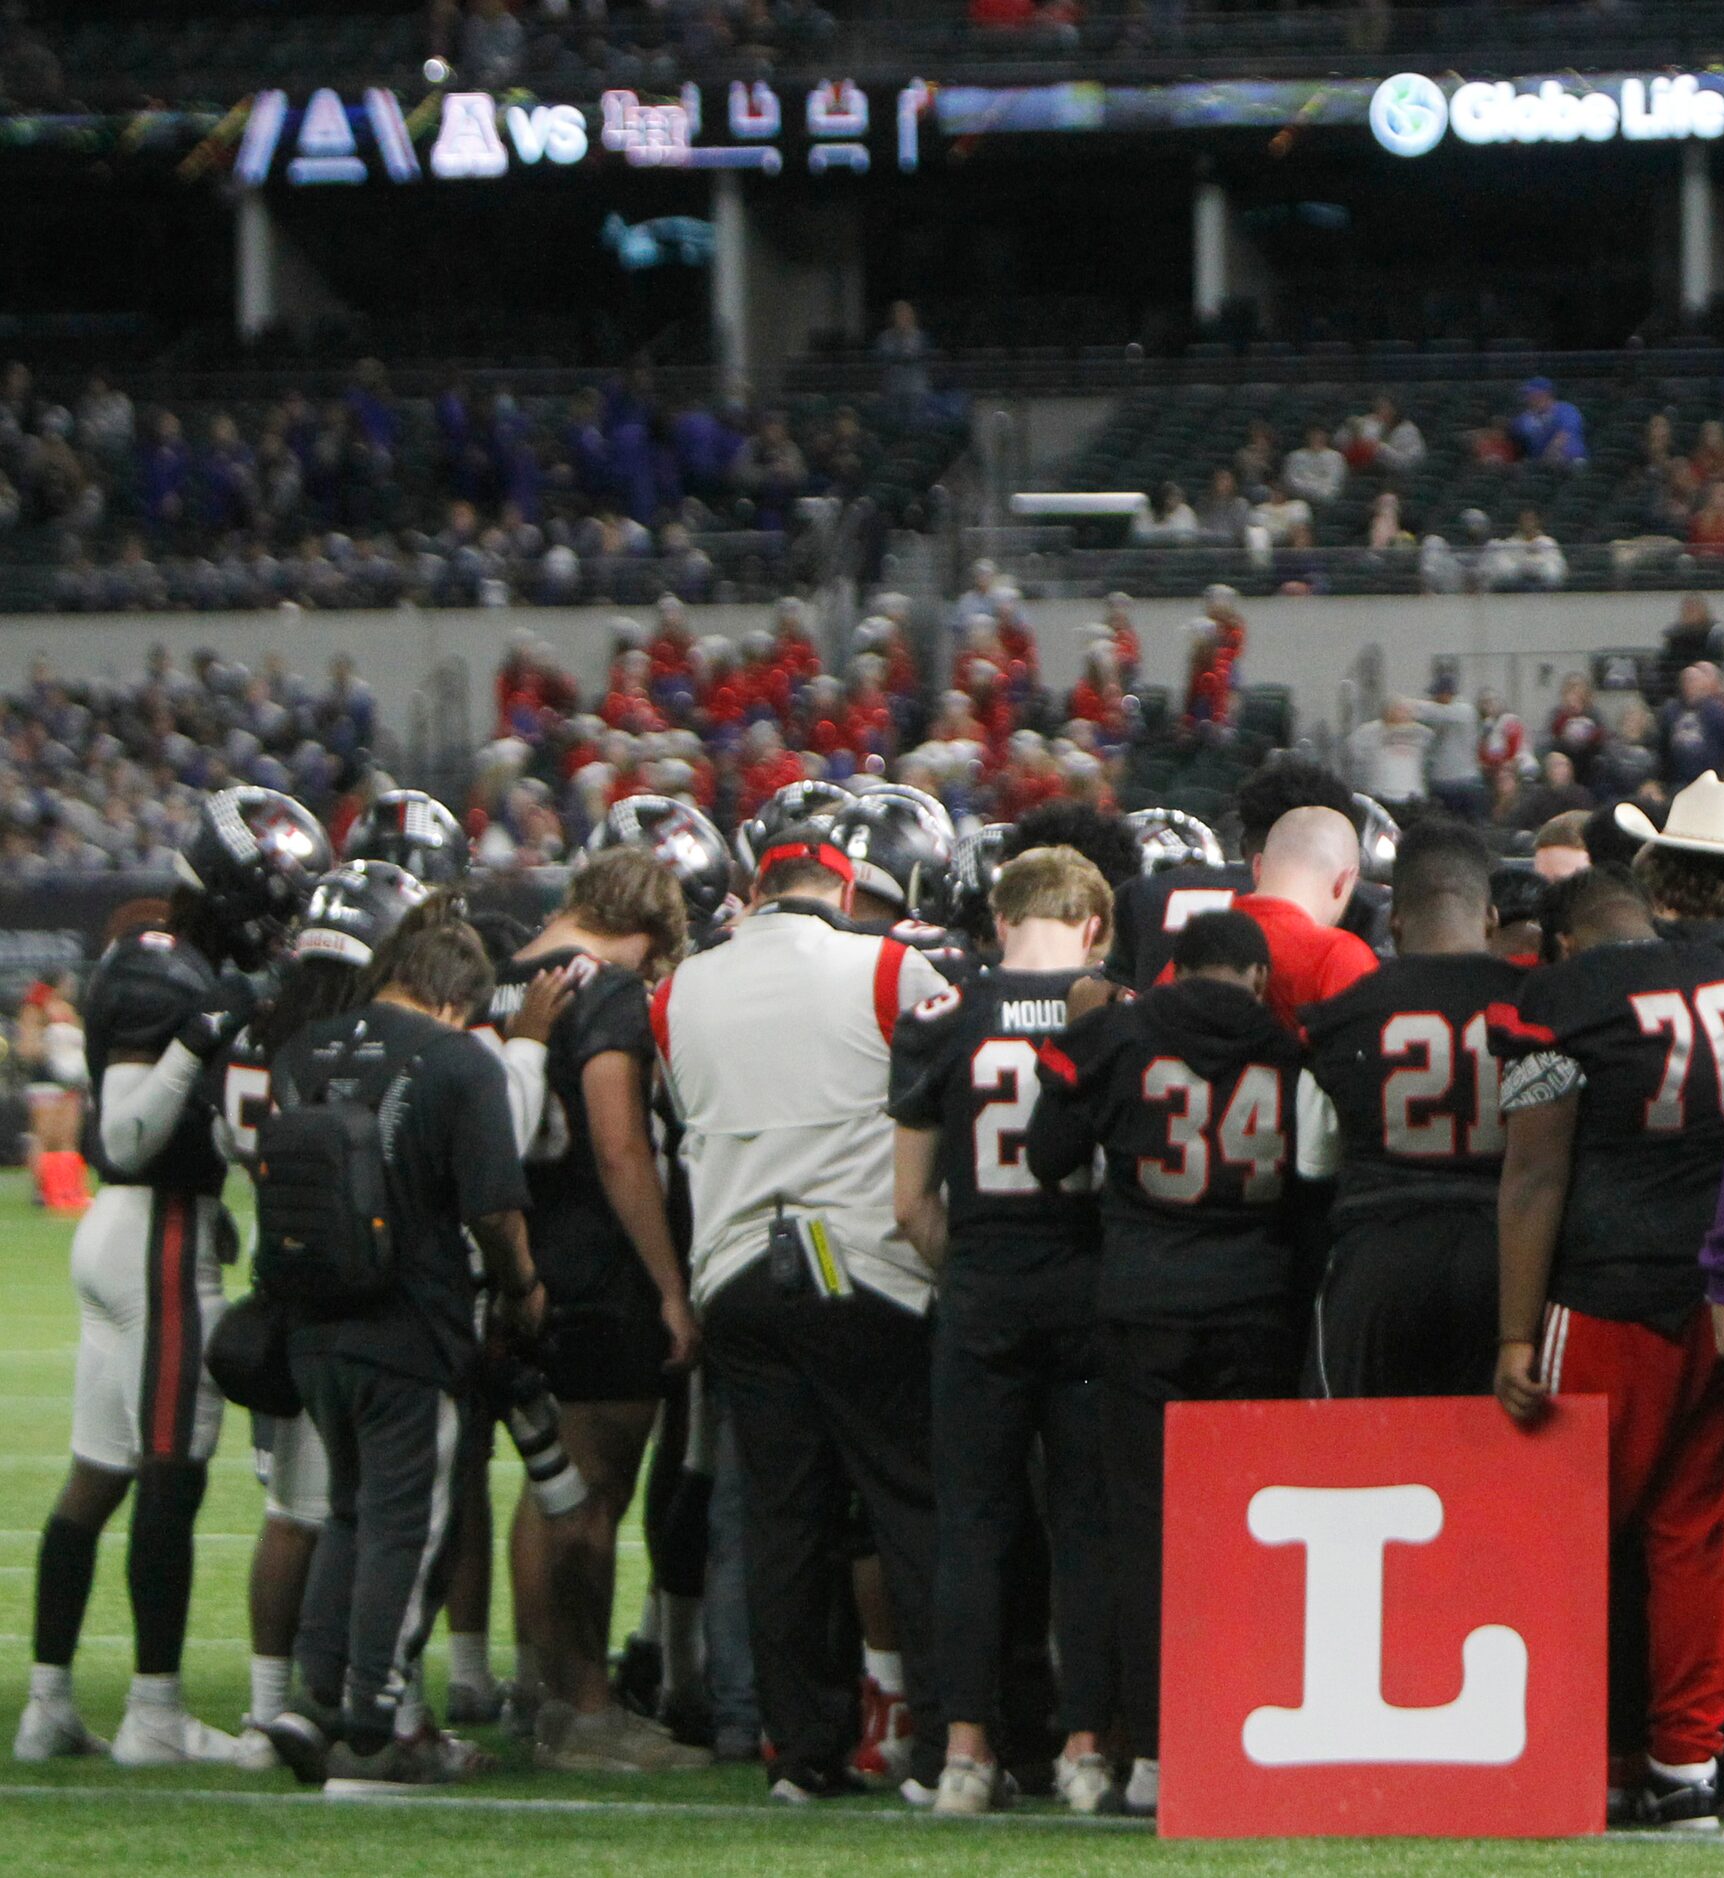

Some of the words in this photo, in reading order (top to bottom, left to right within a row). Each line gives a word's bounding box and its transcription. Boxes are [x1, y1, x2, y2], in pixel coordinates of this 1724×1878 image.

[1450, 80, 1619, 143] Globe
[1137, 1055, 1286, 1203] 34
[1380, 1010, 1508, 1156] 21
[1241, 1483, 1528, 1765] L
